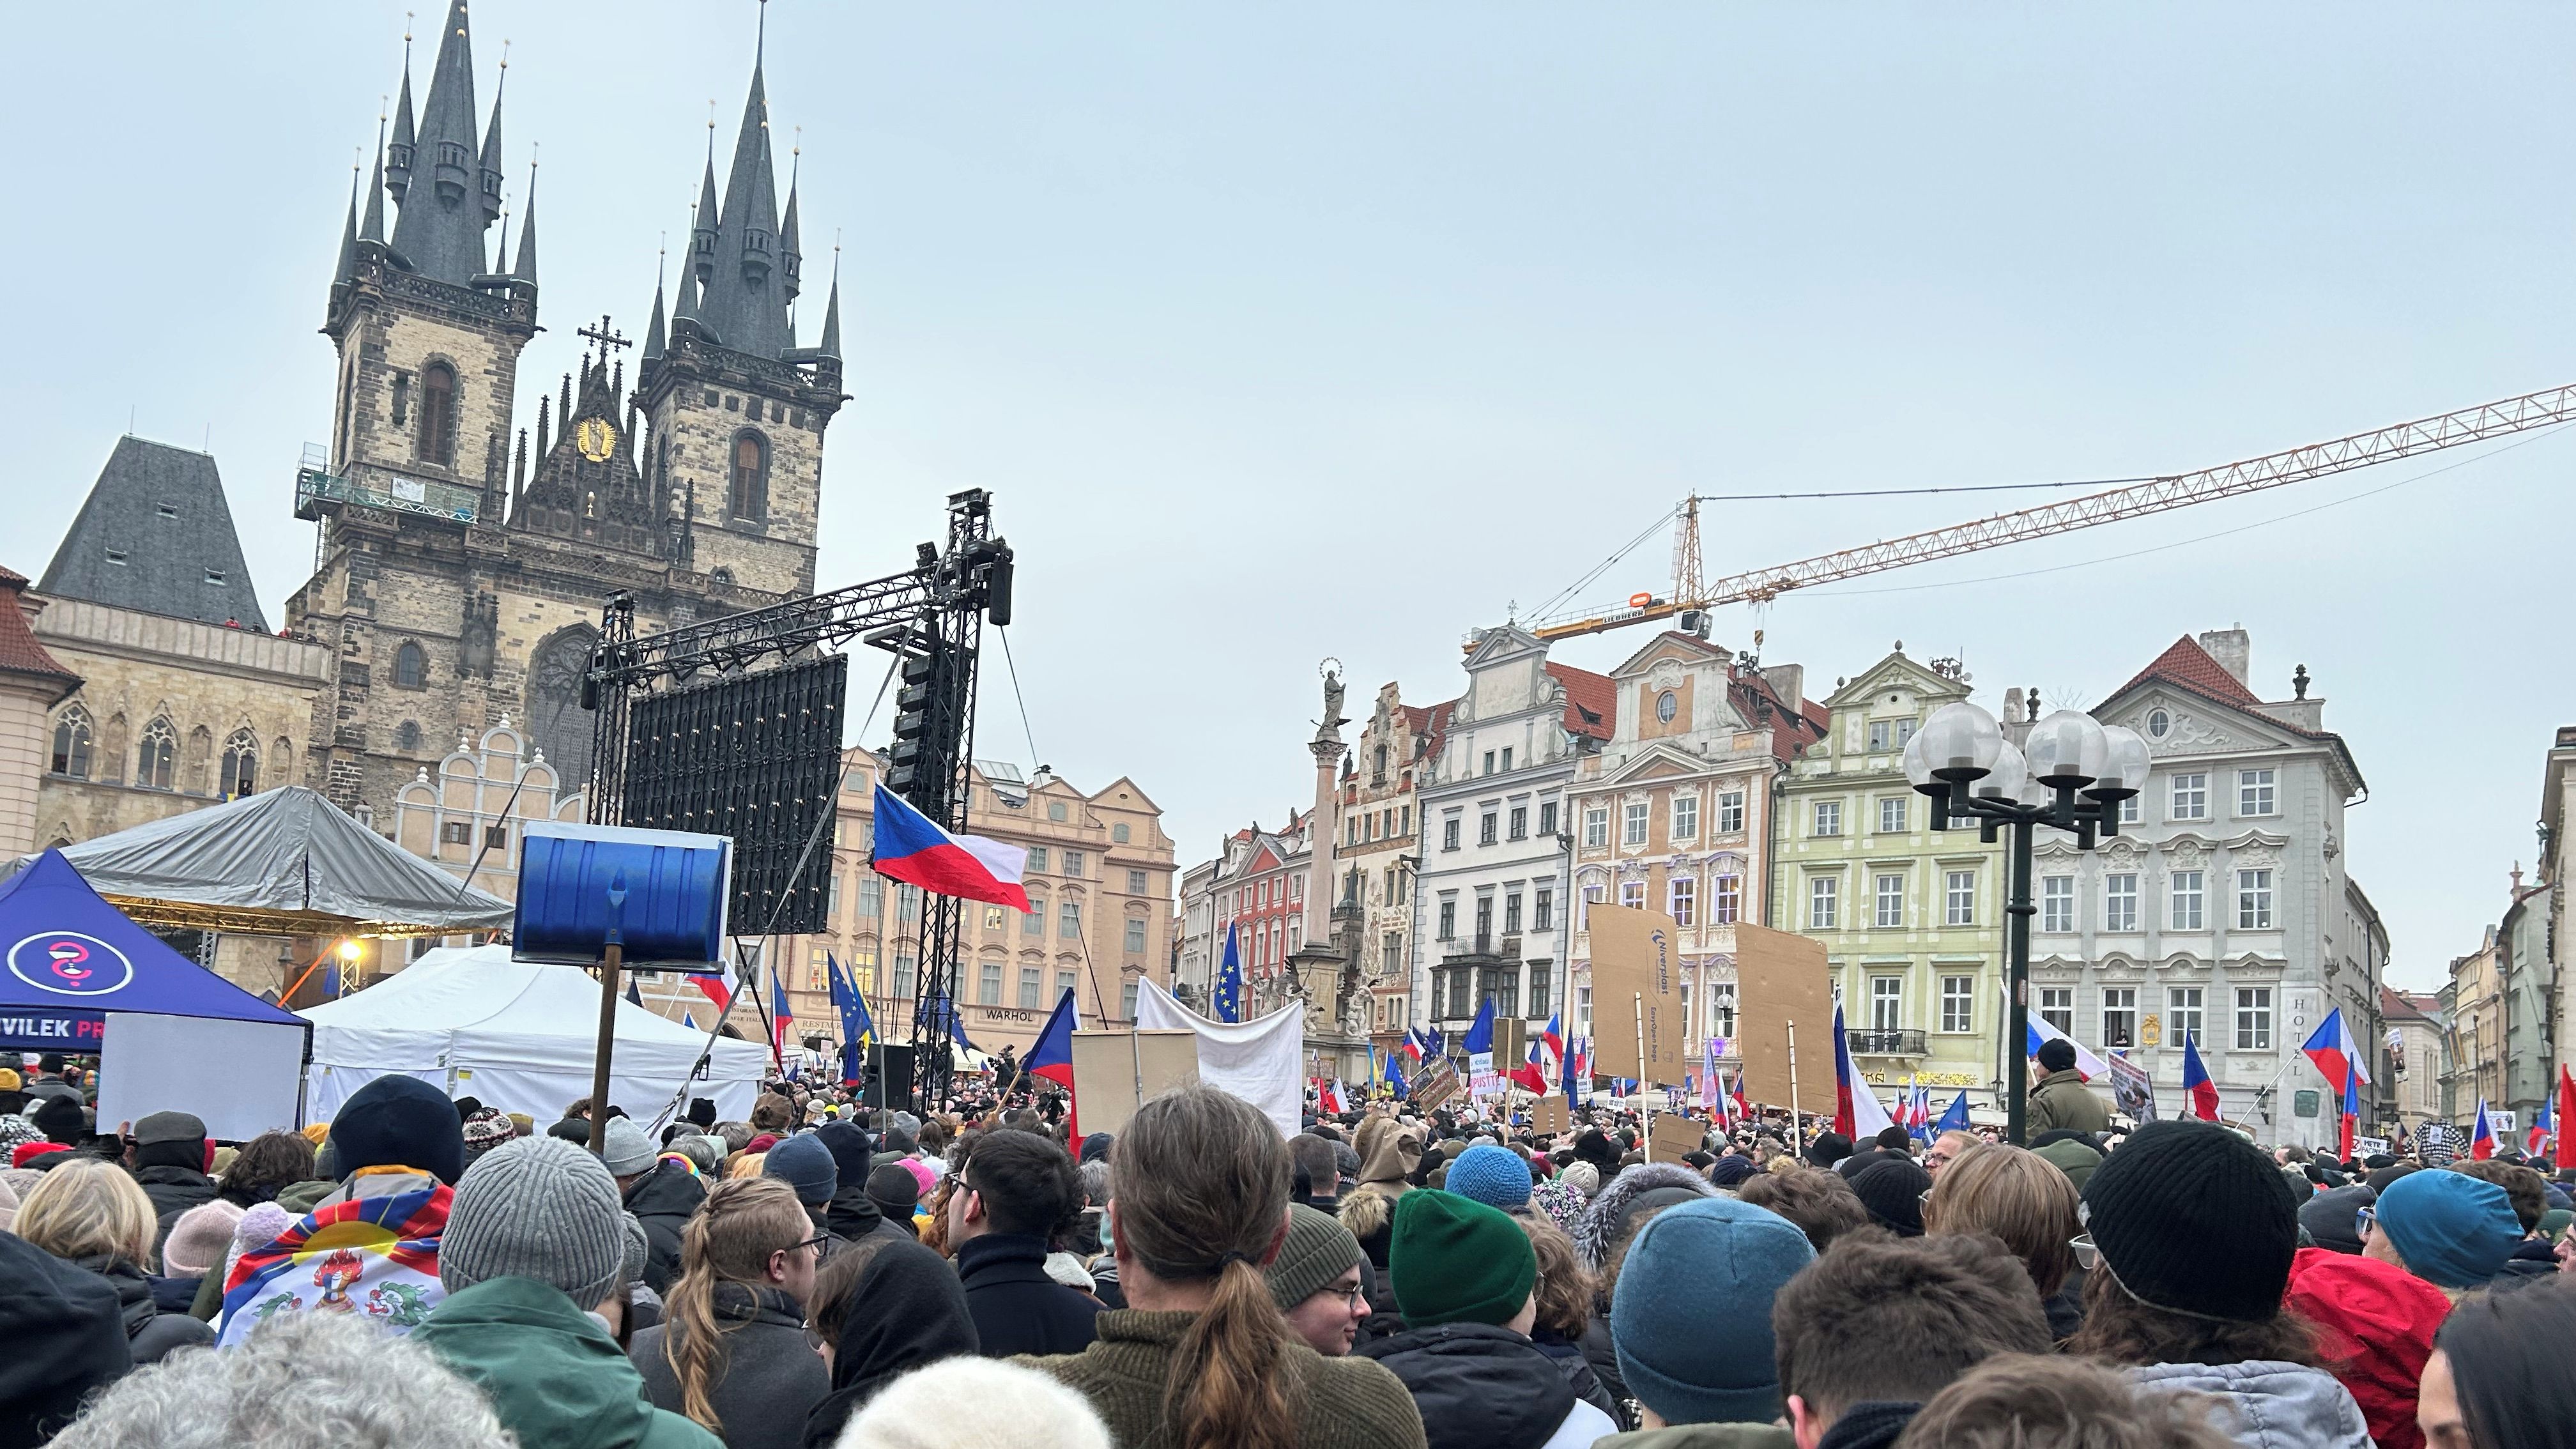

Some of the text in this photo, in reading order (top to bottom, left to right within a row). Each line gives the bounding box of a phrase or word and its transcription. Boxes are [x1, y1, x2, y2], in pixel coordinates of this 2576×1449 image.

[1604, 610, 1644, 624] LIEBHERR
[986, 1009, 1033, 1022] WARHOL
[0, 1018, 71, 1038] VILEK
[2294, 999, 2304, 1077] HOTEL
